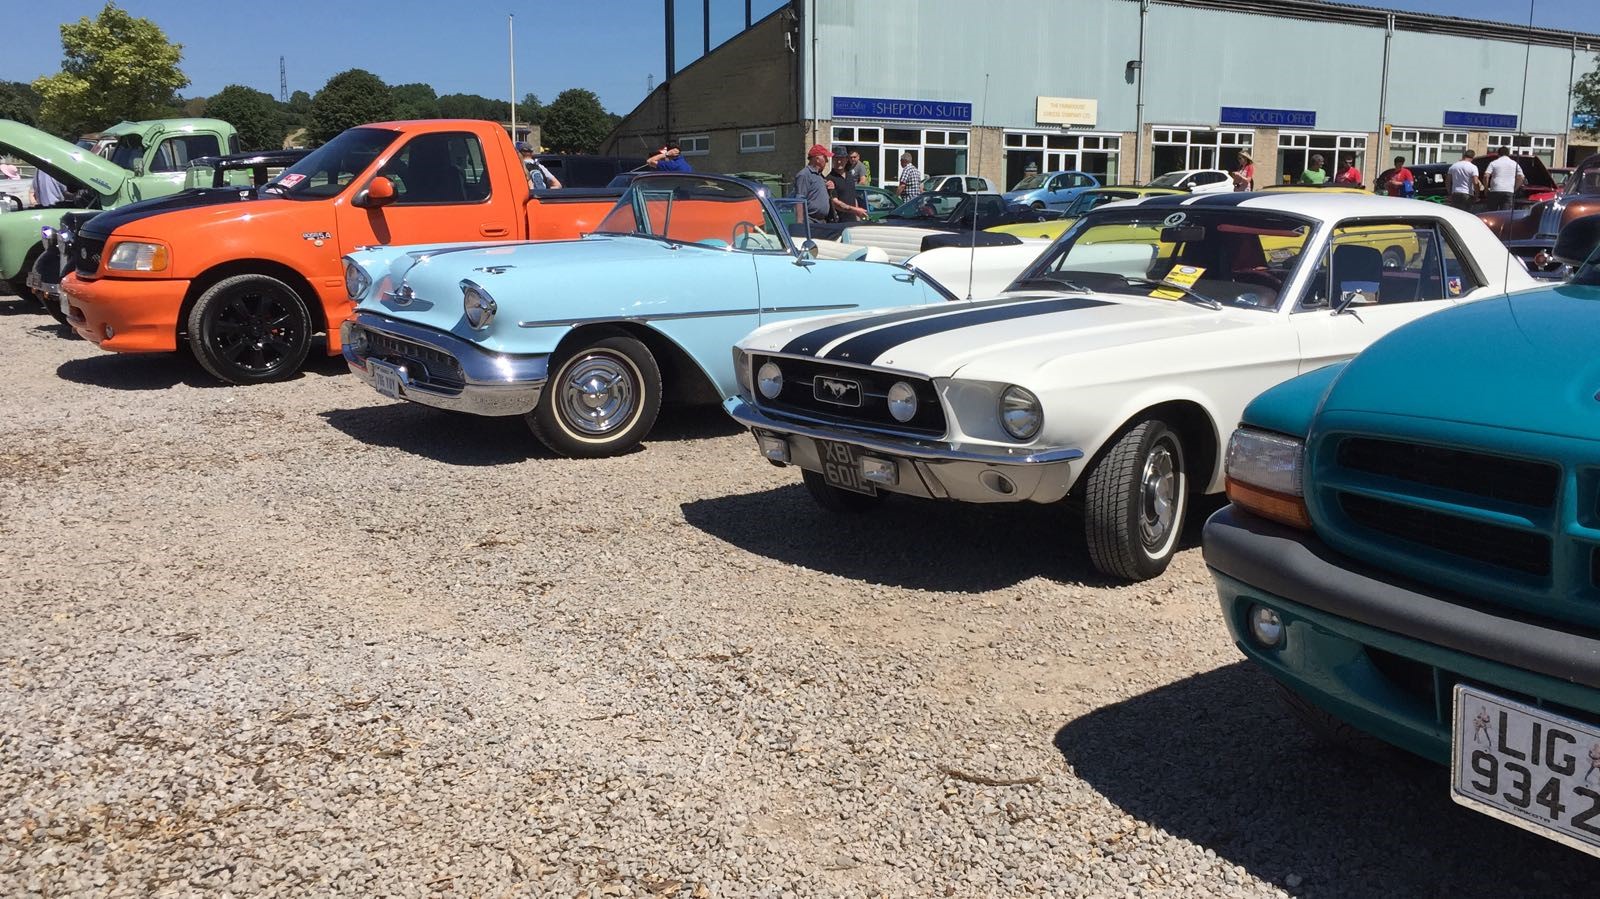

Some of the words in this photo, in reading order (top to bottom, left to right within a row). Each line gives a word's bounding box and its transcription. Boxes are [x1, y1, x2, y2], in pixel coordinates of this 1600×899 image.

[876, 102, 932, 116] SHEPTON
[936, 105, 969, 118] SUITE
[1249, 111, 1284, 123] SOCIETY
[1287, 113, 1314, 124] OFFICE
[1497, 711, 1577, 777] LIG
[1471, 749, 1600, 836] 9342
[1513, 806, 1551, 824] DAKOTA
